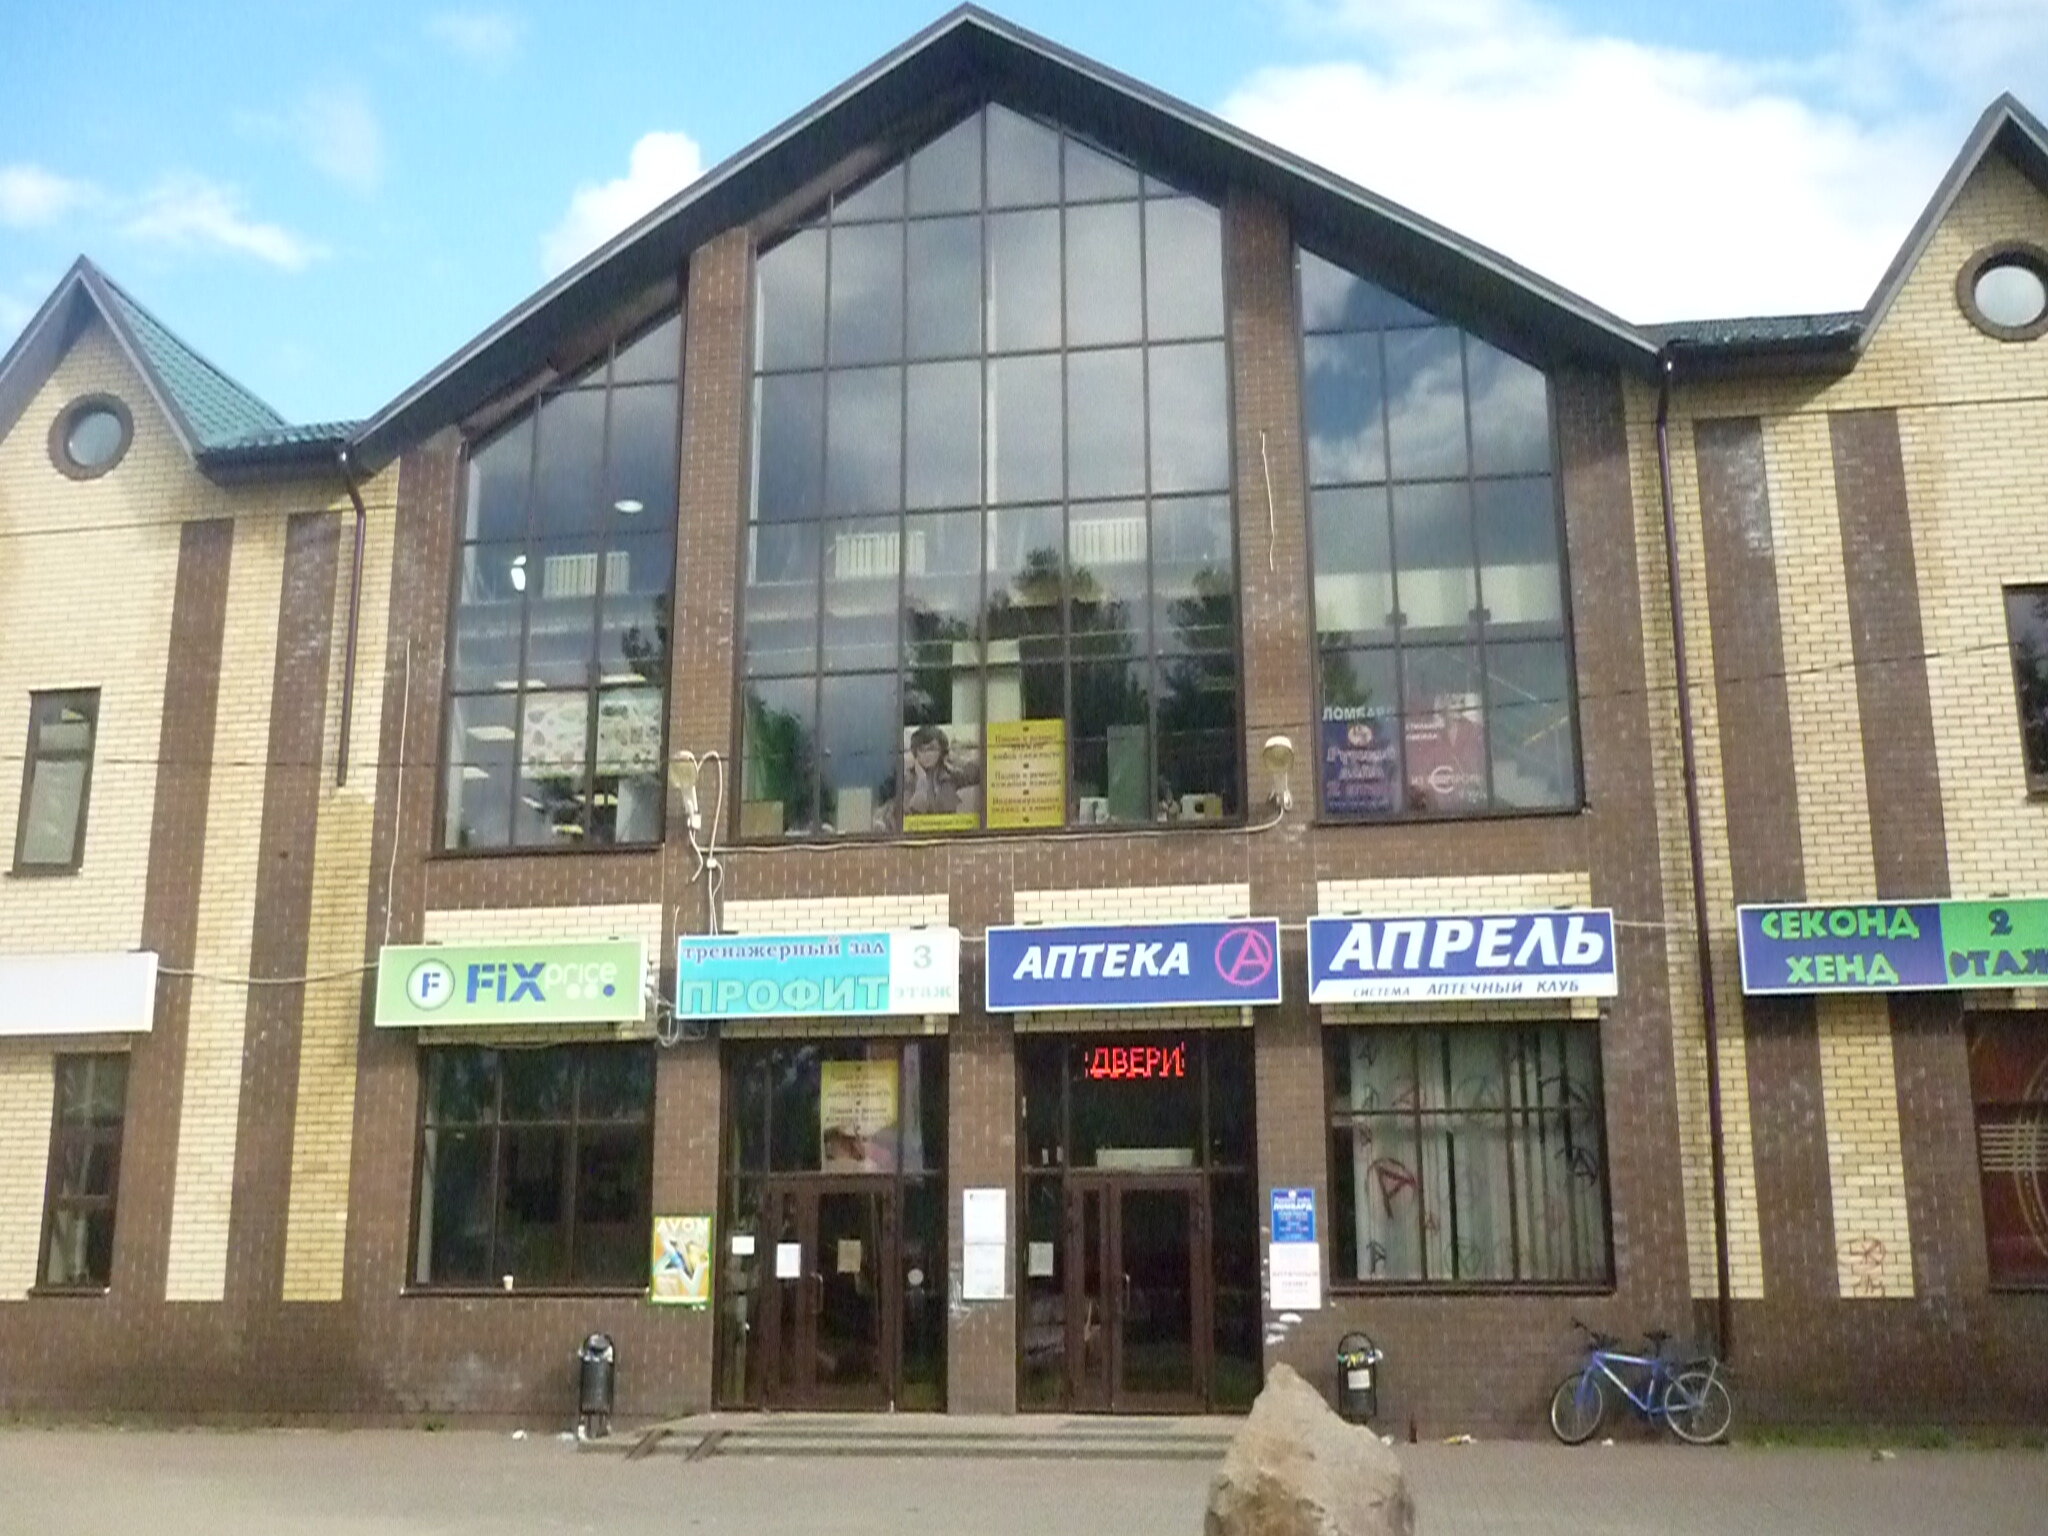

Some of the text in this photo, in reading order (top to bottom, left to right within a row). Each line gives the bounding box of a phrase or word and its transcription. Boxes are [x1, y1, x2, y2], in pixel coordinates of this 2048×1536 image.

[1761, 908, 1920, 939] СЕКОНД
[1988, 908, 2013, 936] 2
[682, 936, 885, 963] тренажерный зал
[913, 945, 932, 969] 3
[1329, 917, 1604, 971] АПРЕЛЬ
[1012, 942, 1190, 980] АПТЕКА
[1785, 953, 1900, 986] ХЕНД
[680, 975, 890, 1014] ПРОФИТ
[1427, 979, 1523, 996] АПТЕЧНЫЙ
[1537, 979, 1580, 993] КЛУБ
[1090, 1046, 1184, 1078] ДВЕРИ
[656, 1218, 709, 1232] AVON
